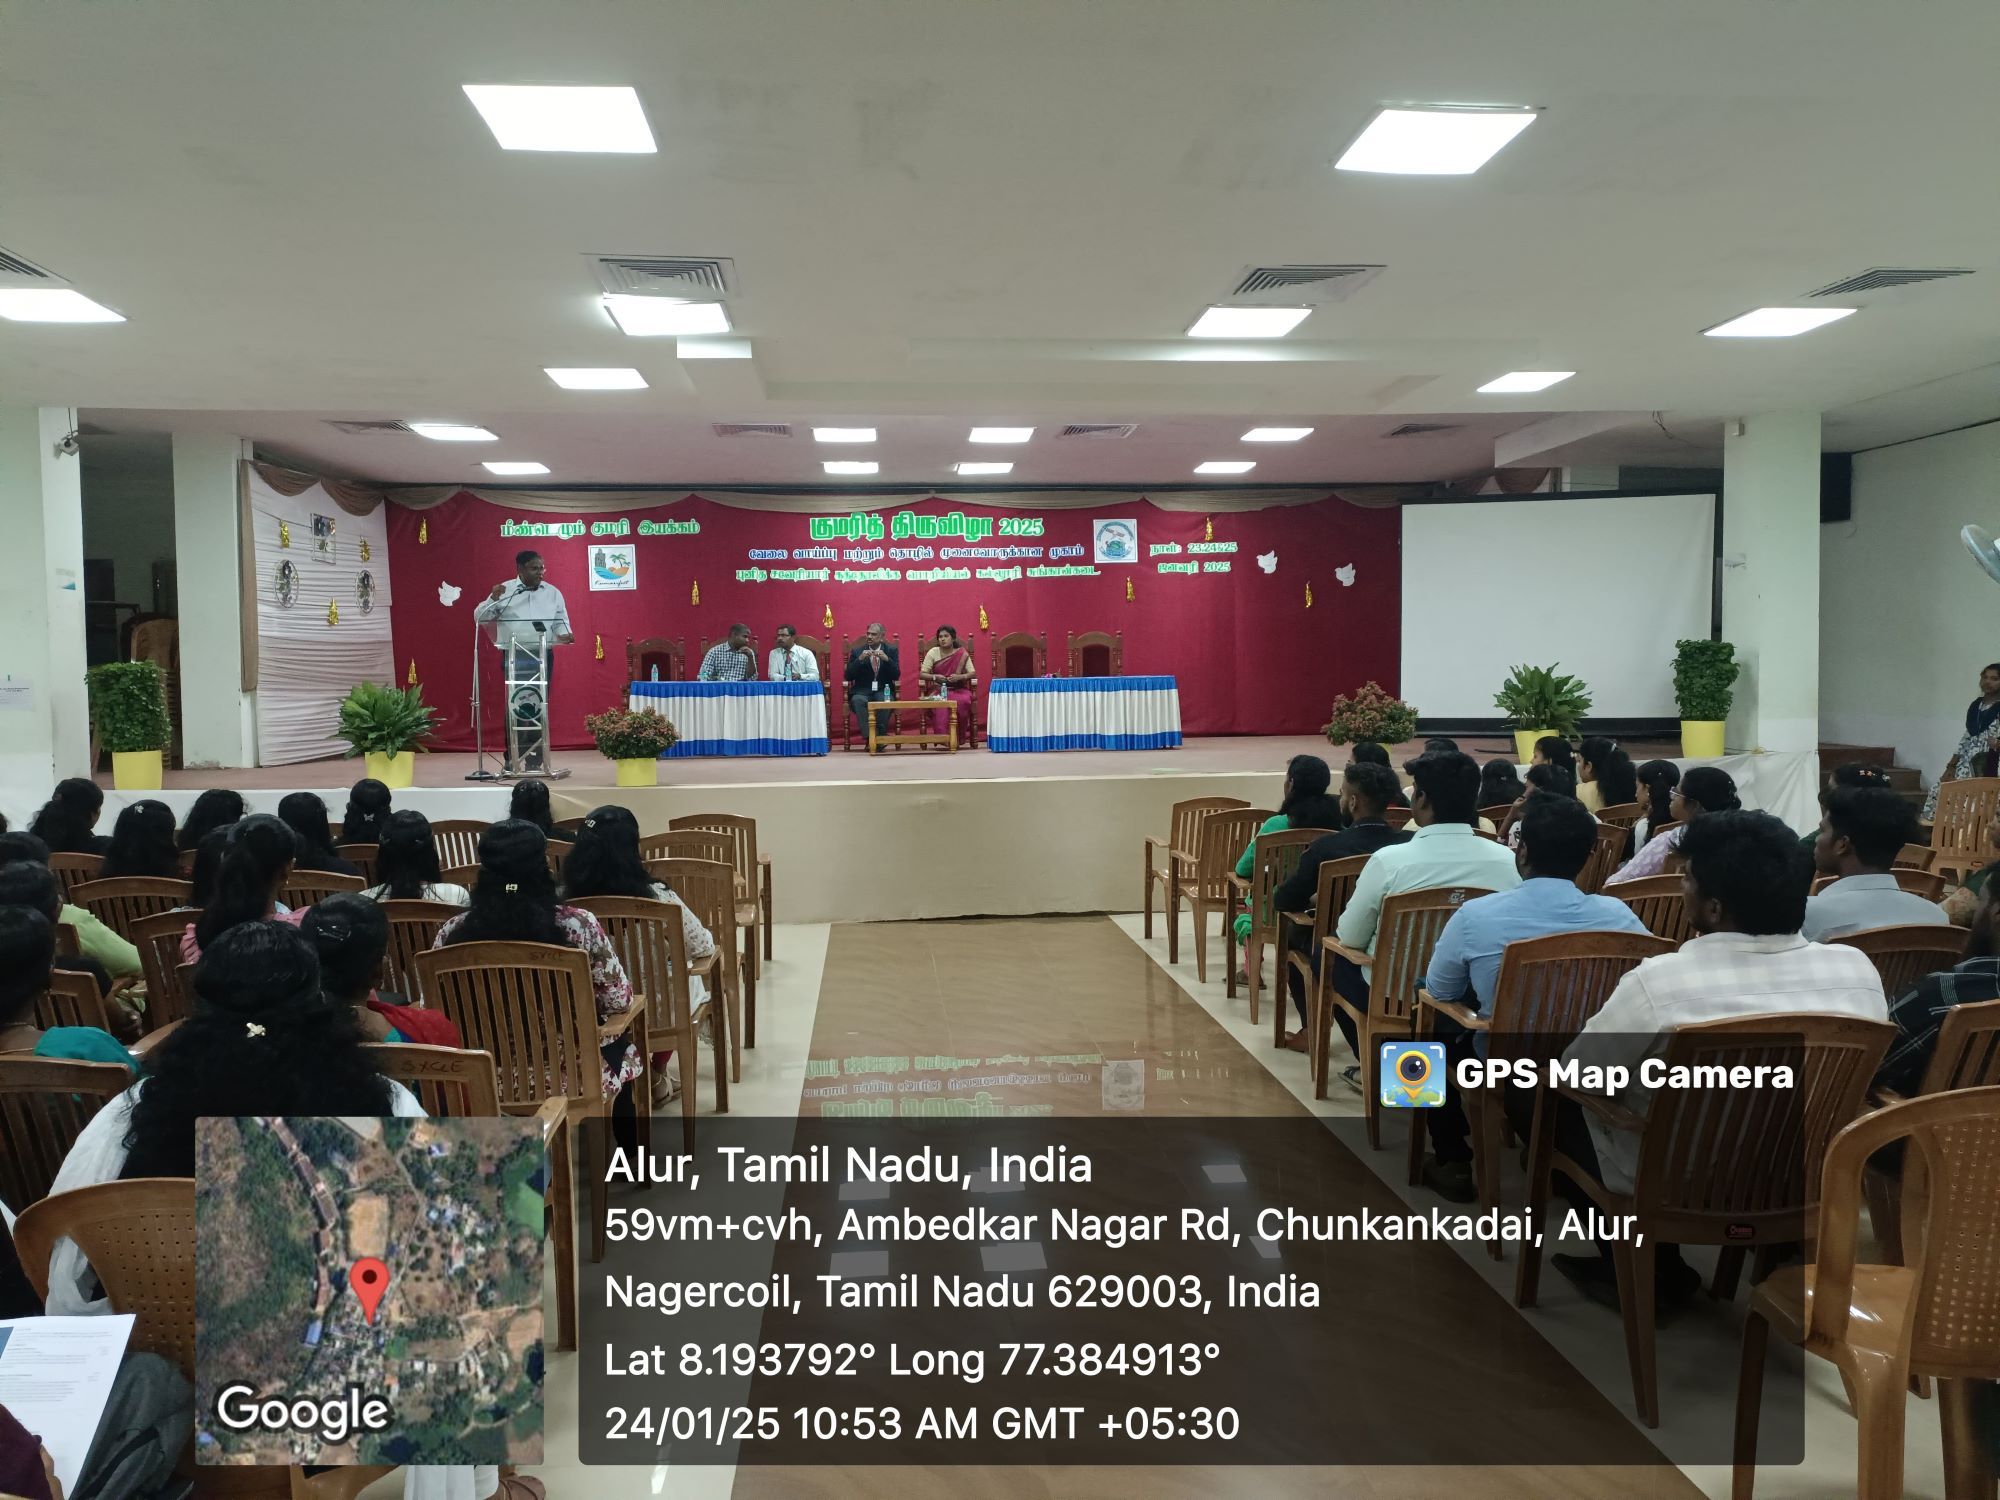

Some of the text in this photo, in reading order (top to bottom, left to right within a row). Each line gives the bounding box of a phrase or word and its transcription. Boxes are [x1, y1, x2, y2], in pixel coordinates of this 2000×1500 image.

[591, 517, 630, 538] குமரி
[637, 518, 700, 536] இயக்கம்
[810, 511, 1044, 542] குமரித் திருவிழா 2025
[749, 549, 788, 560] வேலை
[793, 546, 837, 561] வாய்ப்பு
[843, 547, 884, 563] மற்றும்
[889, 545, 934, 561] தொழில்
[1049, 543, 1084, 559] முகாம்
[735, 567, 768, 581] புனித
[1203, 561, 1231, 573] 2025
